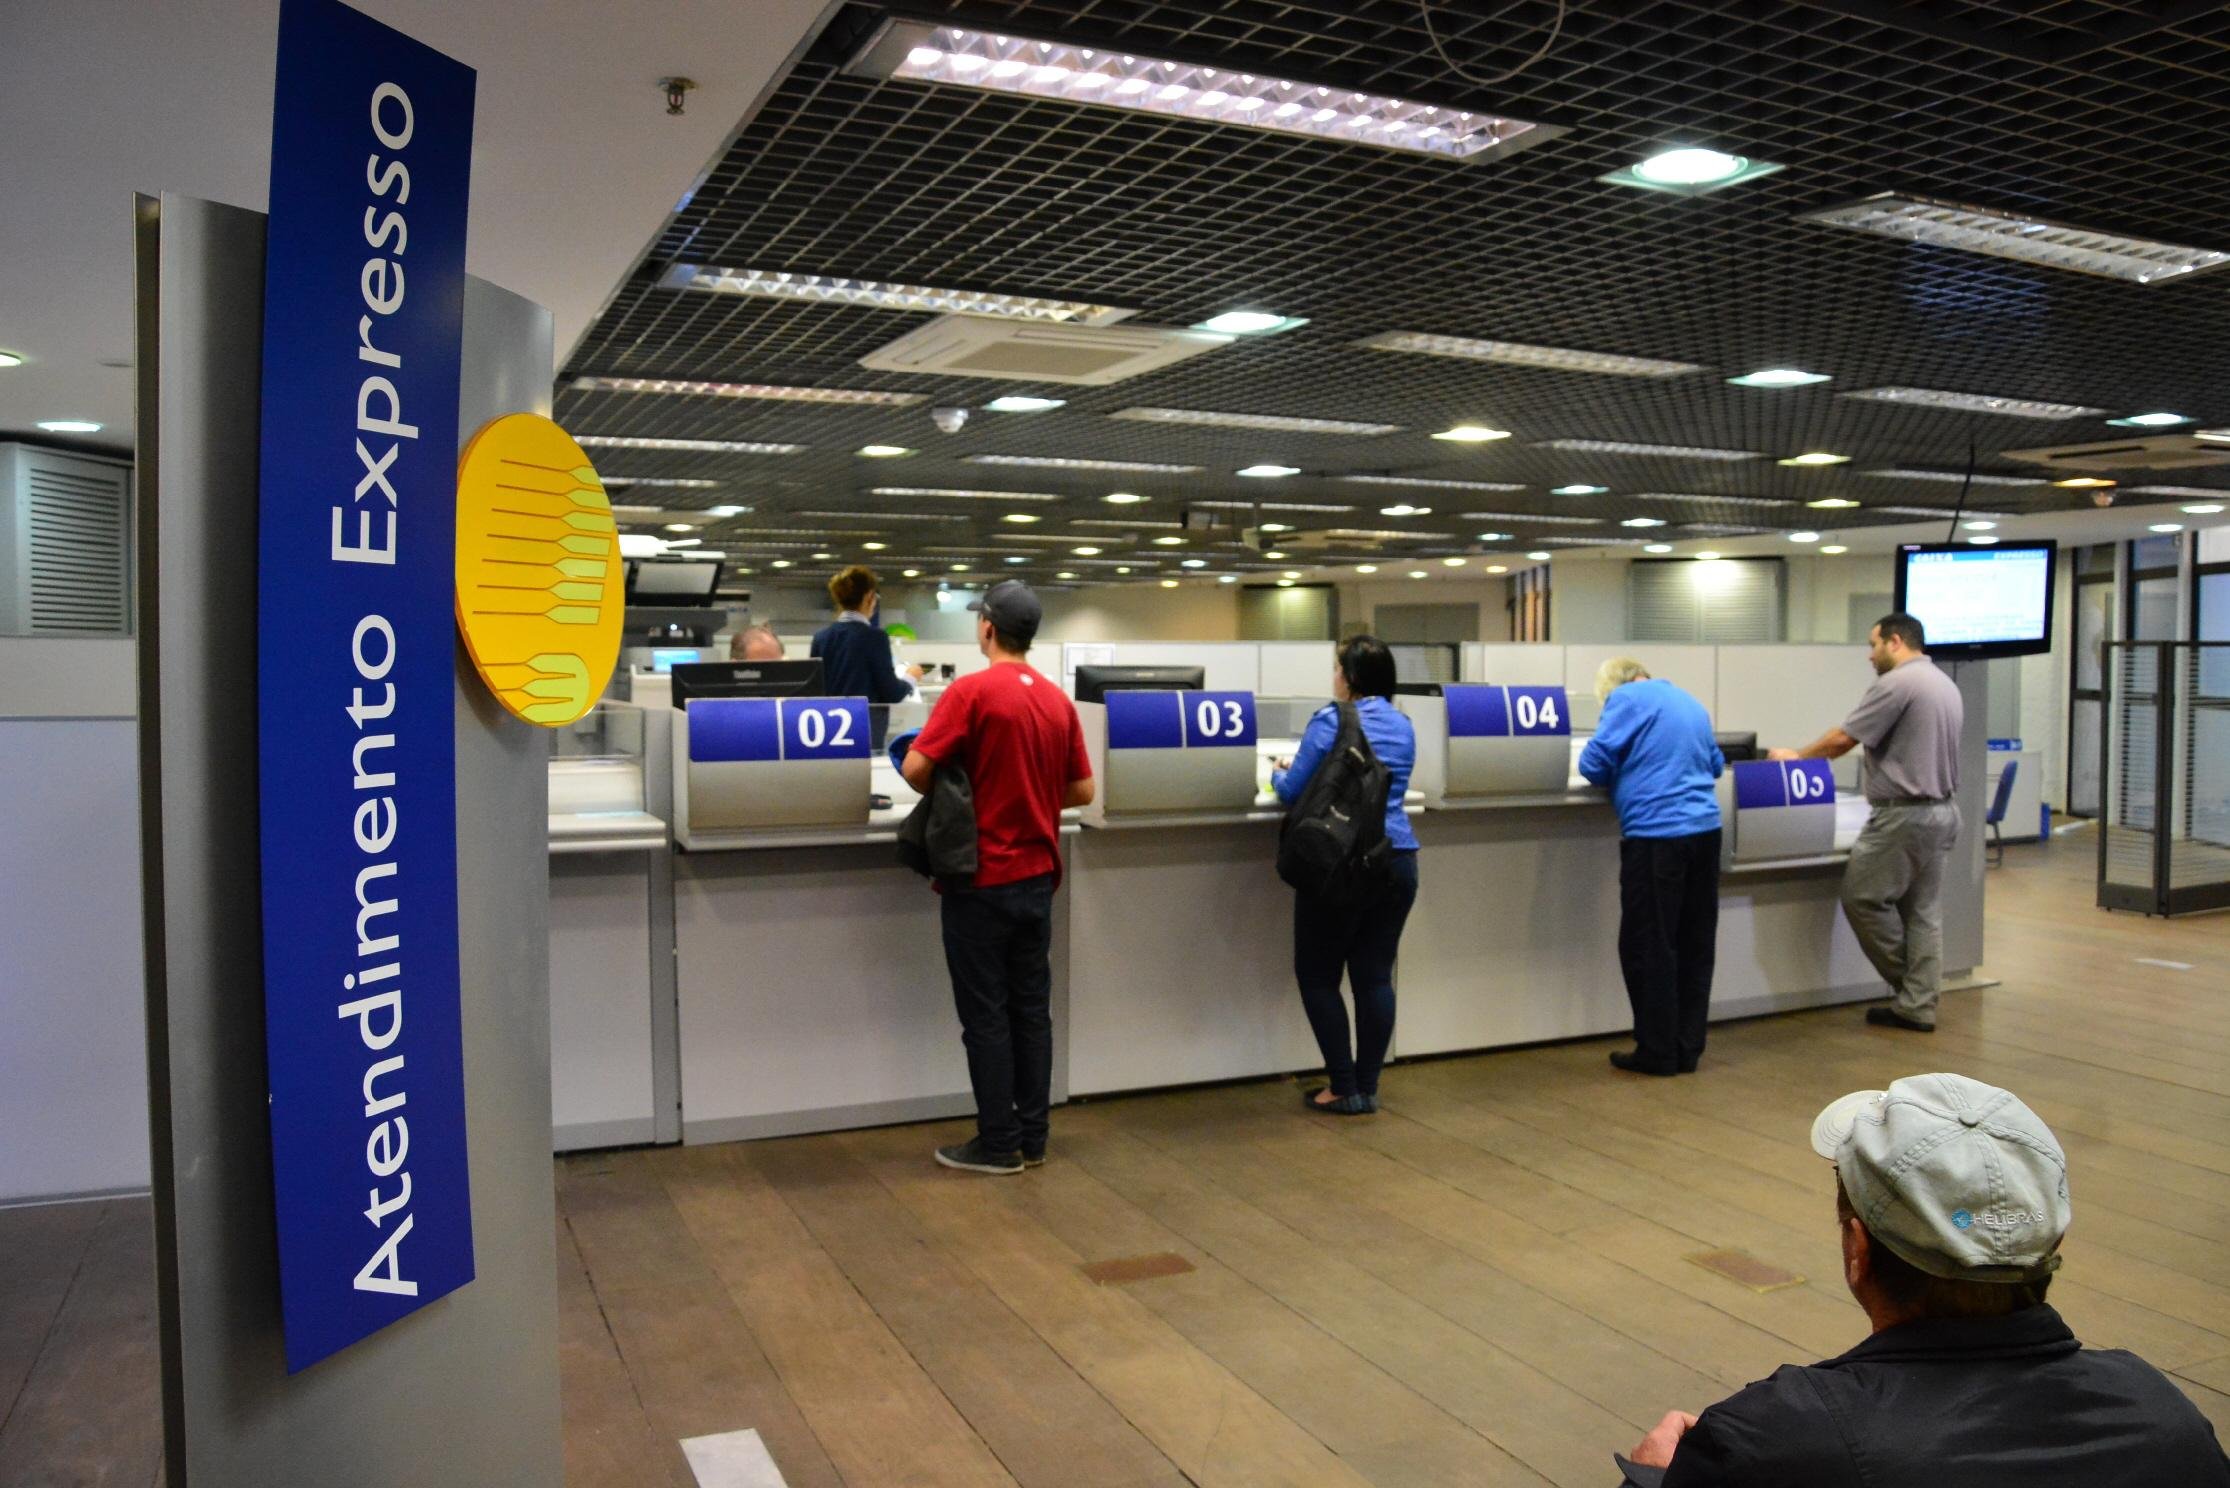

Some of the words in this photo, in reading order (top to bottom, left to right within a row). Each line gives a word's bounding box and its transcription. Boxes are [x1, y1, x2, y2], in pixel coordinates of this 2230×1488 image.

[331, 82, 419, 565] Expresso
[797, 707, 855, 748] 02
[1197, 699, 1244, 738] 03
[1516, 694, 1560, 729] 04
[337, 614, 419, 1297] Atendimento
[1972, 1210, 2044, 1225] HELIBRAS
